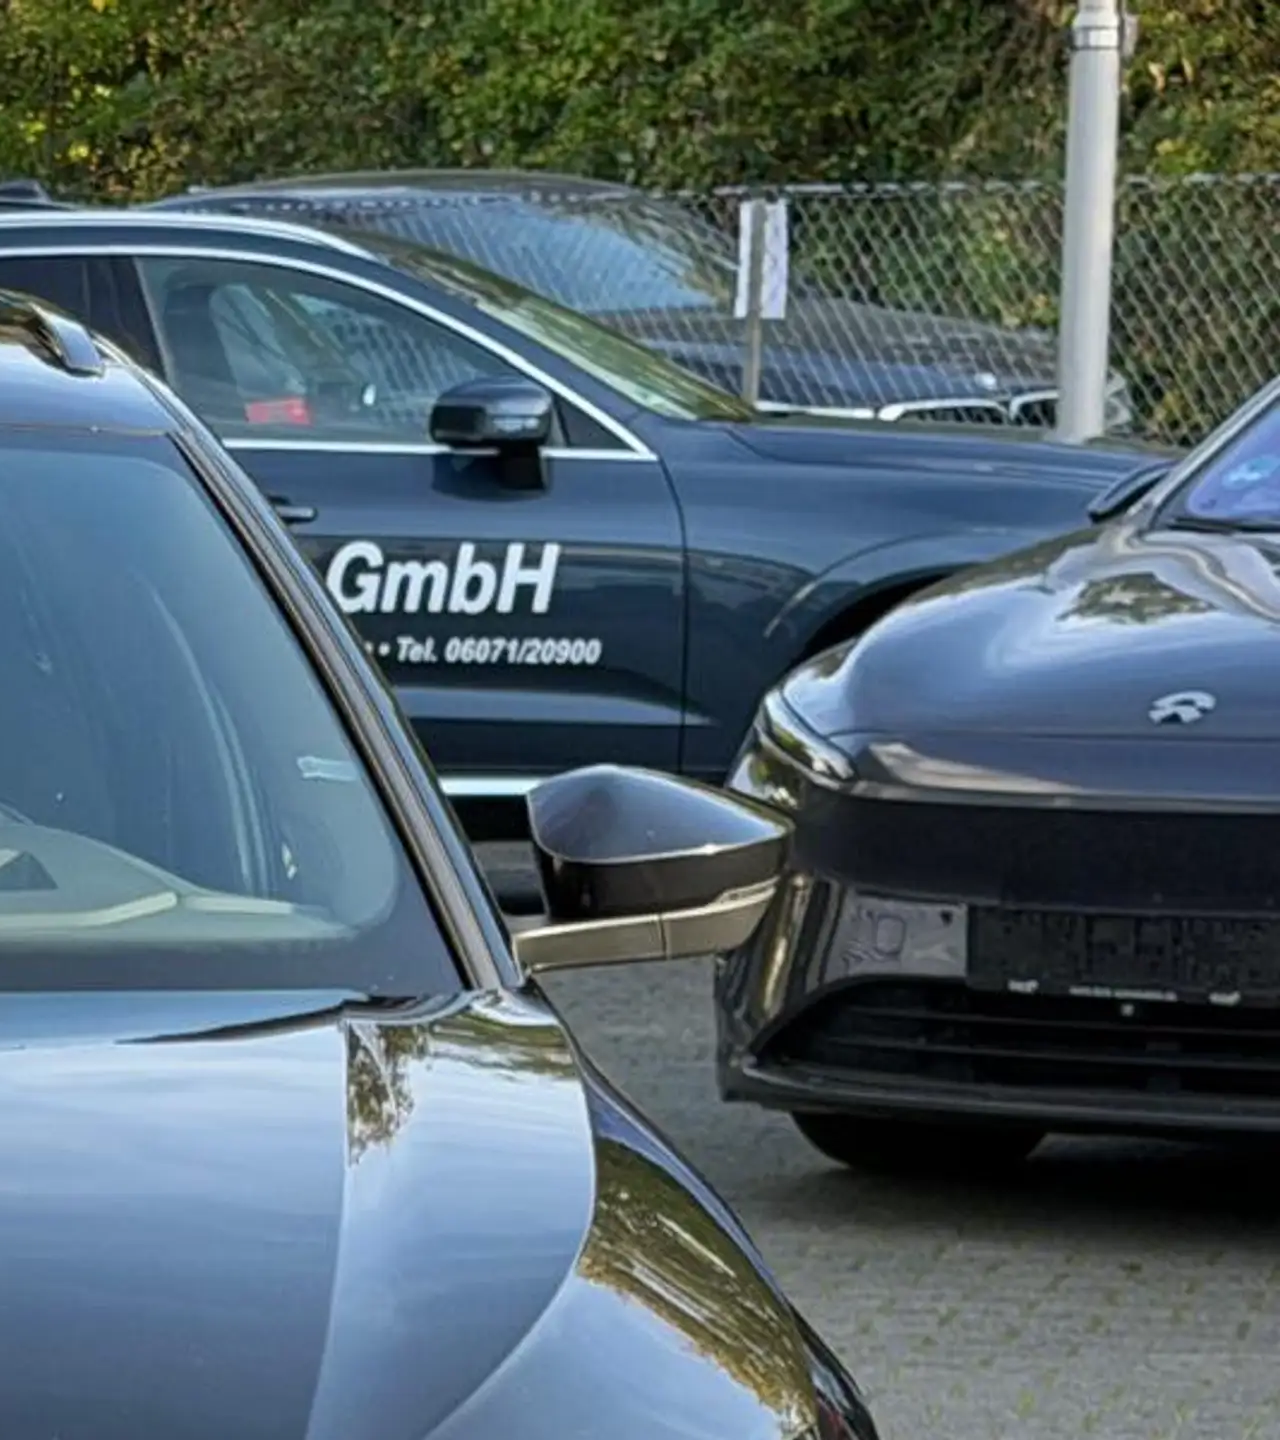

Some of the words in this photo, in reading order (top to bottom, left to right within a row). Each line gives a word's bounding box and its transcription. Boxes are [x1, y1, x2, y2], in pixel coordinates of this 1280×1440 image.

[326, 540, 561, 615] GmbH
[396, 636, 438, 663] Tel.
[444, 637, 602, 665] 06071/20900
